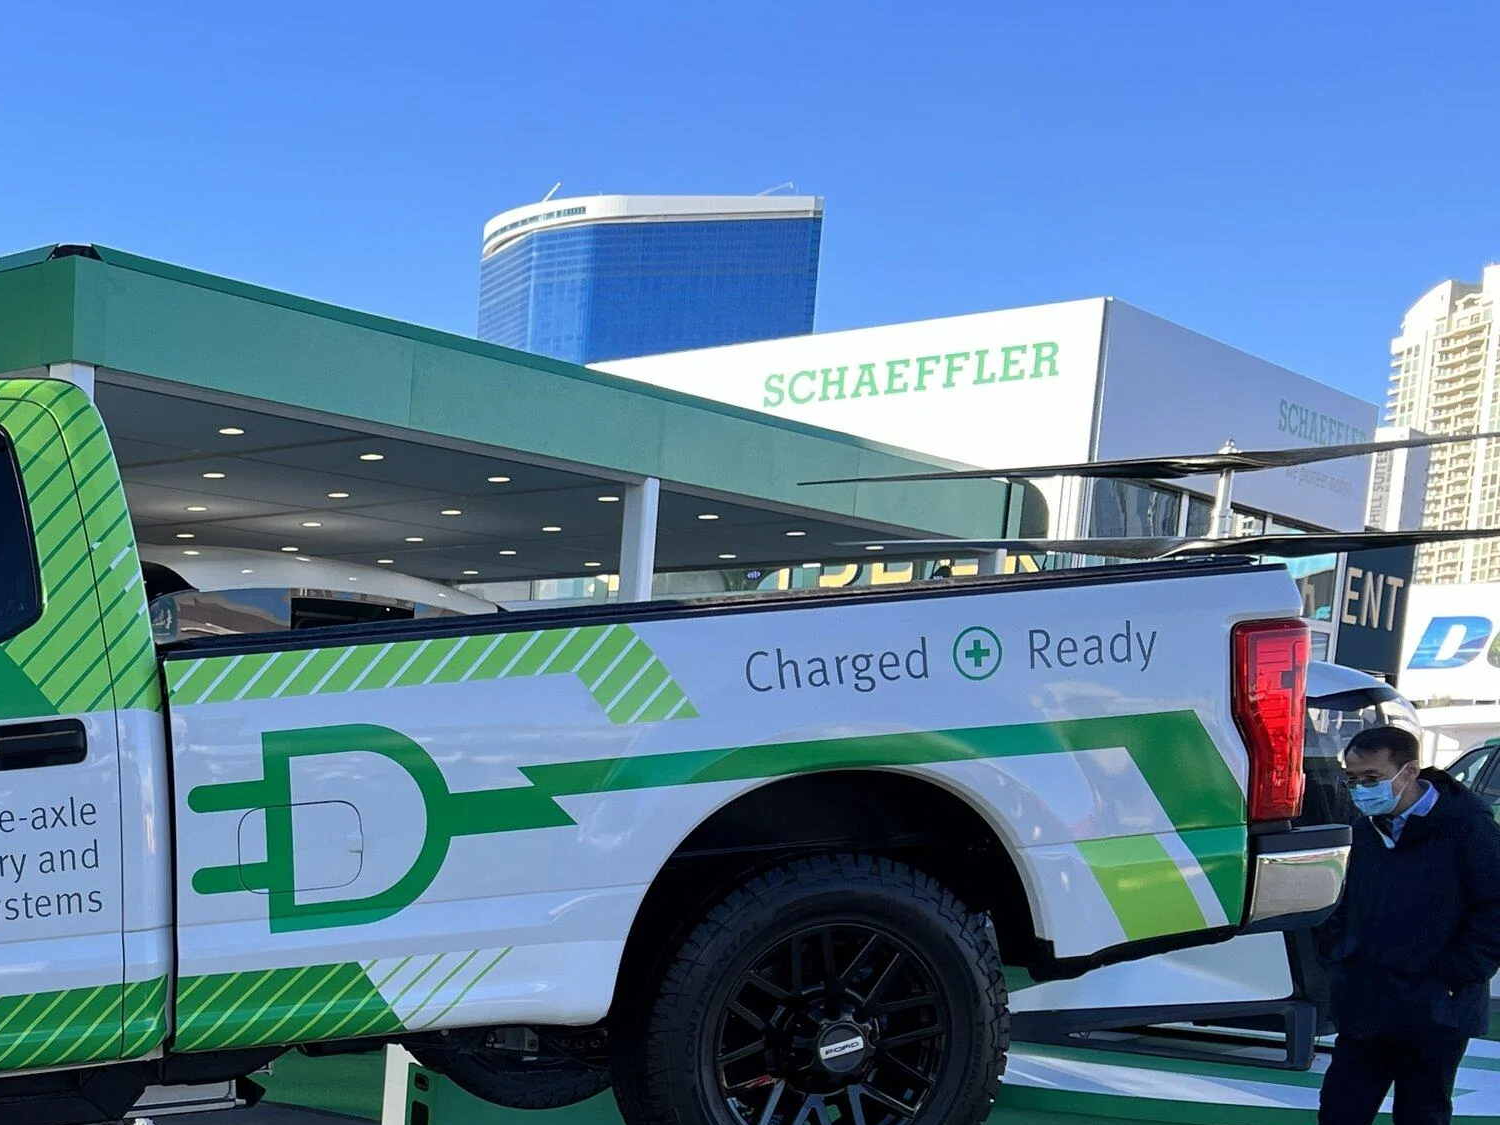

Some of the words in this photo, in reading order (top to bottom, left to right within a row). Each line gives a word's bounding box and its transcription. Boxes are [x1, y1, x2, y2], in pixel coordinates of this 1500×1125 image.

[763, 341, 1060, 407] SCHAEFFLER
[745, 636, 929, 692] Charged
[1029, 620, 1158, 672] Ready
[39, 839, 100, 874] and
[825, 1041, 860, 1055] FORD
